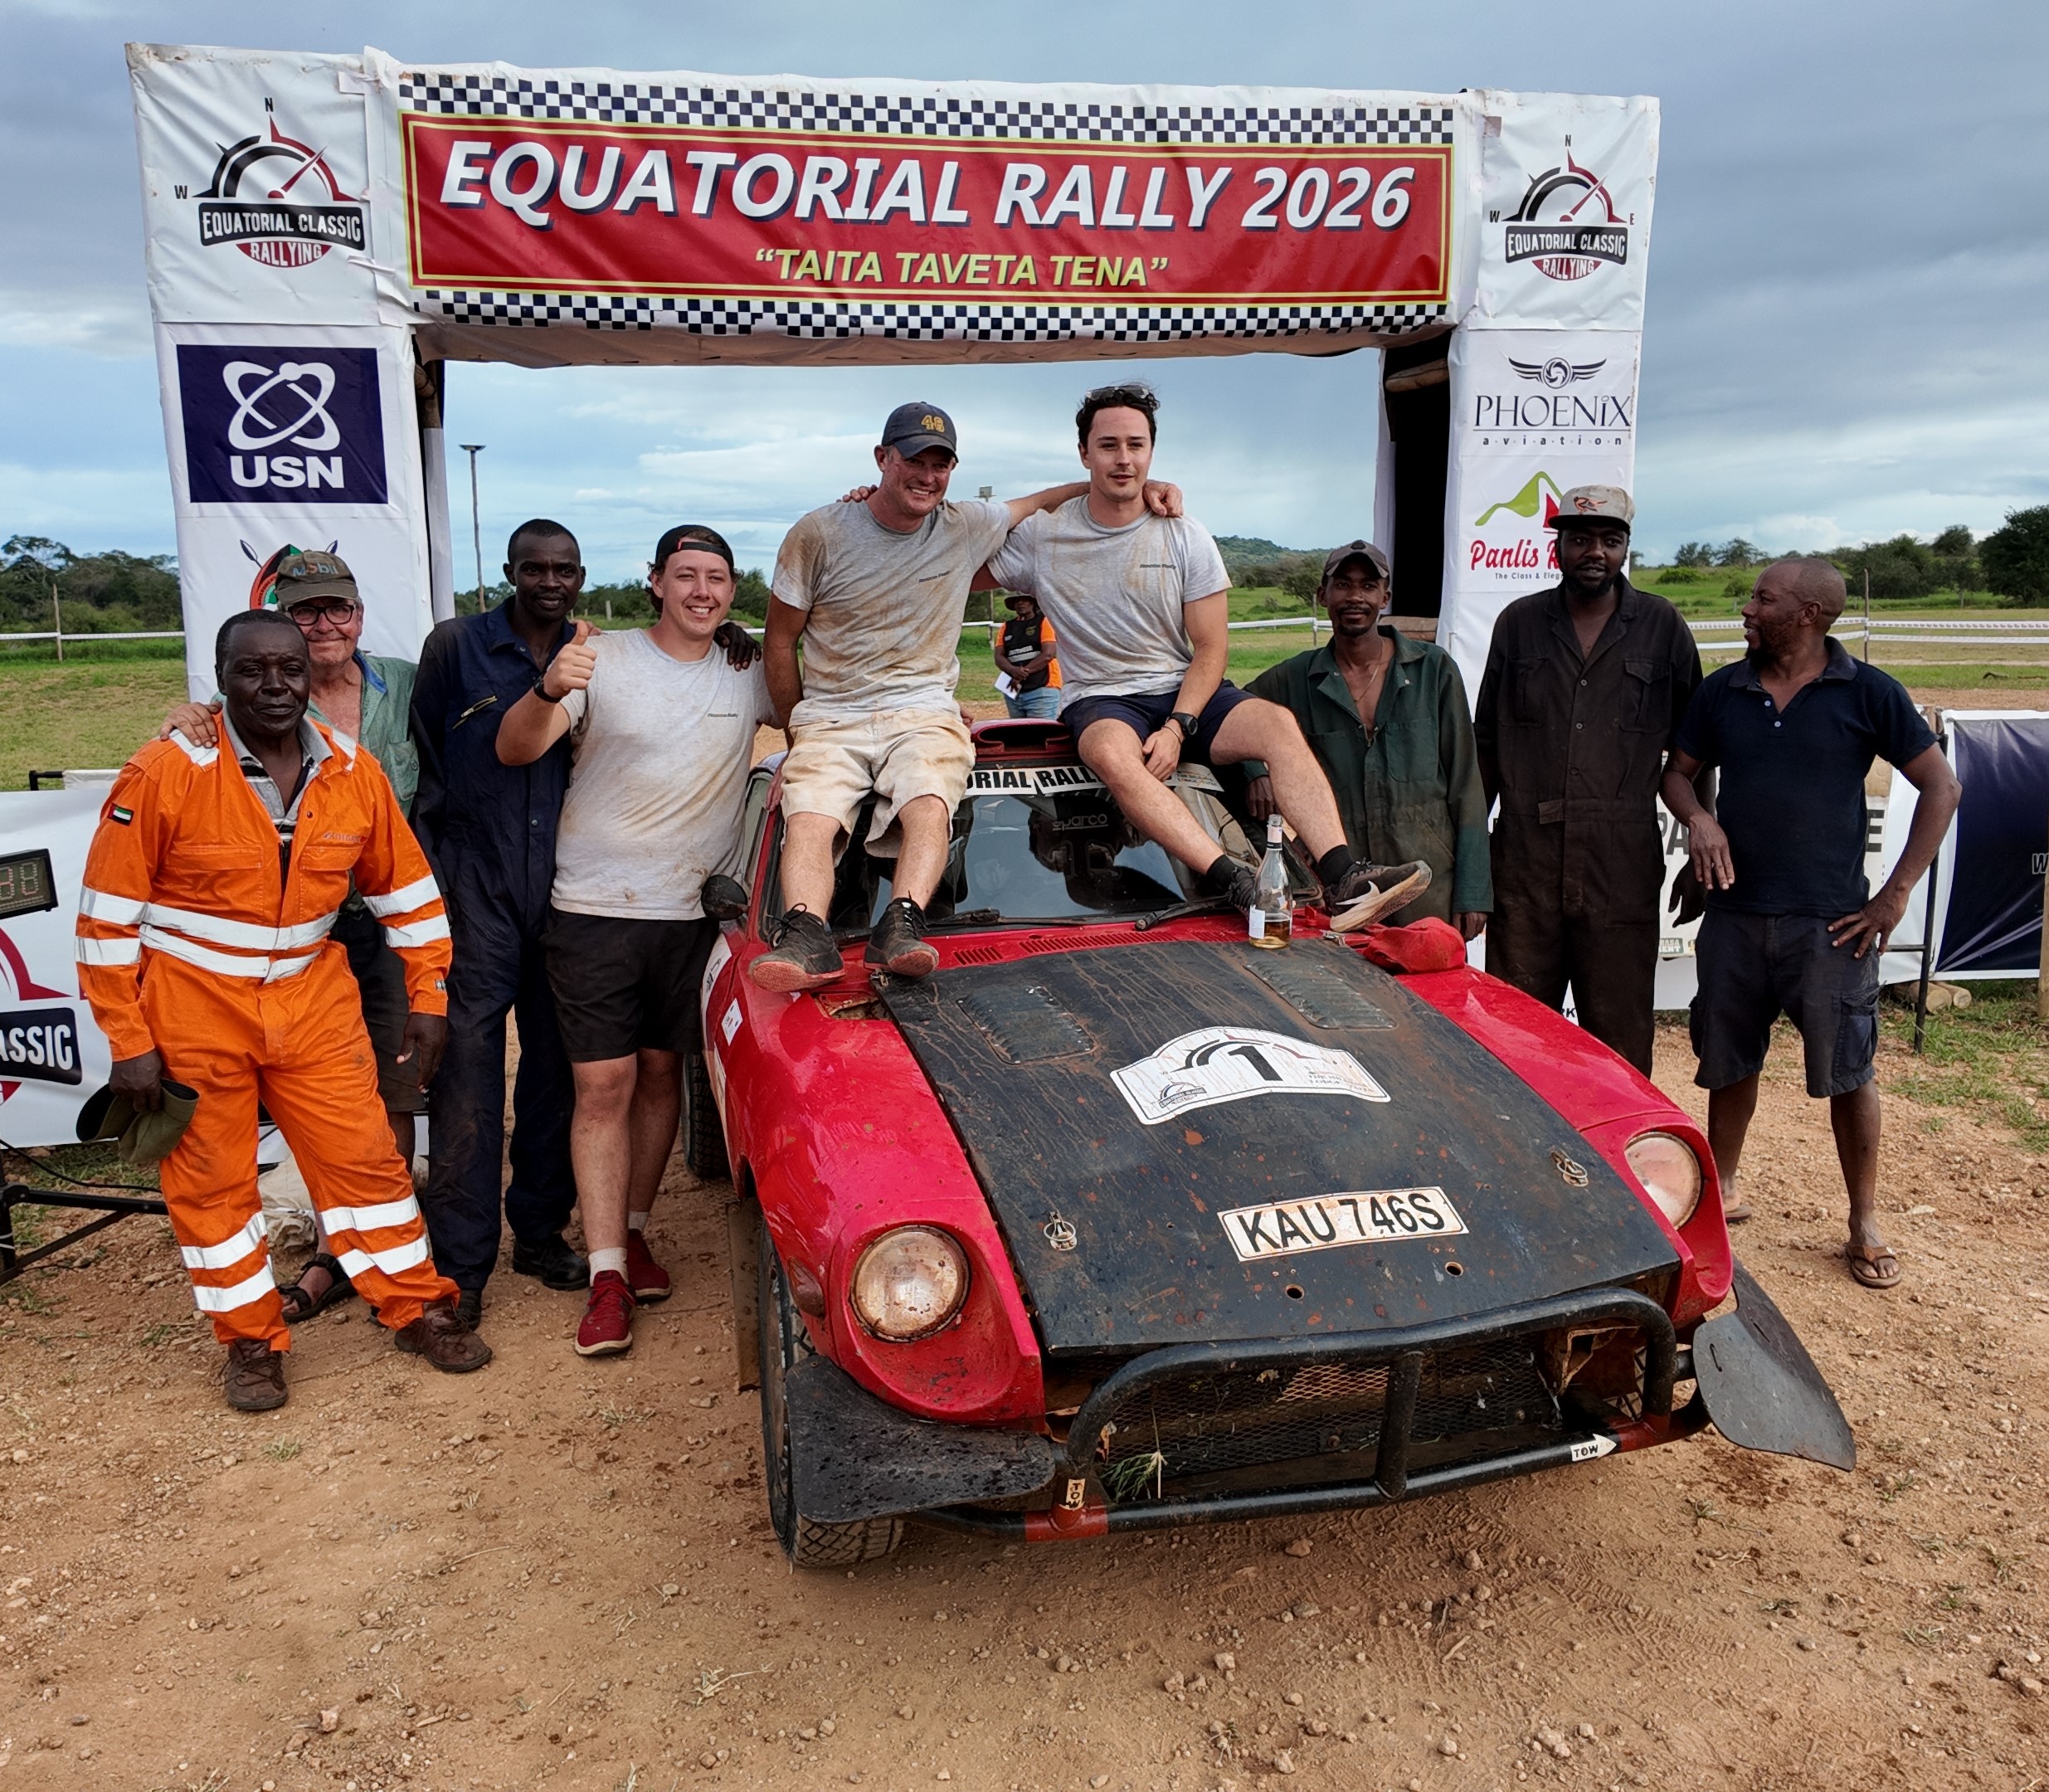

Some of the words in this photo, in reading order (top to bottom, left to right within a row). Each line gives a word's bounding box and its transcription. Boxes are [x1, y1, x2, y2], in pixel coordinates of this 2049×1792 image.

[265, 97, 274, 112] N
[1565, 134, 1572, 147] N
[174, 185, 188, 199] W
[440, 140, 969, 231] EQUATORIAL
[994, 163, 1233, 231] RALLY
[1241, 166, 1415, 231] 2026
[202, 212, 294, 240] EQUATORIAL
[298, 213, 362, 242] CLASSIC
[1490, 210, 1501, 223] W
[1629, 212, 1635, 226] E
[250, 241, 323, 267] RALLYING
[1507, 232, 1577, 258] EQUATORIAL
[1579, 233, 1626, 257] CLASSIC
[896, 251, 1038, 286] TAVETA
[1542, 257, 1594, 280] RALLYING
[229, 455, 345, 489] USN
[1470, 538, 1540, 572] Panlis
[1495, 572, 1509, 580] The
[1511, 572, 1532, 580] Class
[1535, 572, 1540, 580] &
[1035, 766, 1102, 788] RALL
[1229, 1045, 1284, 1081] 1
[1237, 1201, 1336, 1253] KAU
[1337, 1192, 1445, 1237] 746S
[1573, 1444, 1599, 1458] TOW
[1065, 1483, 1083, 1508] TOW
